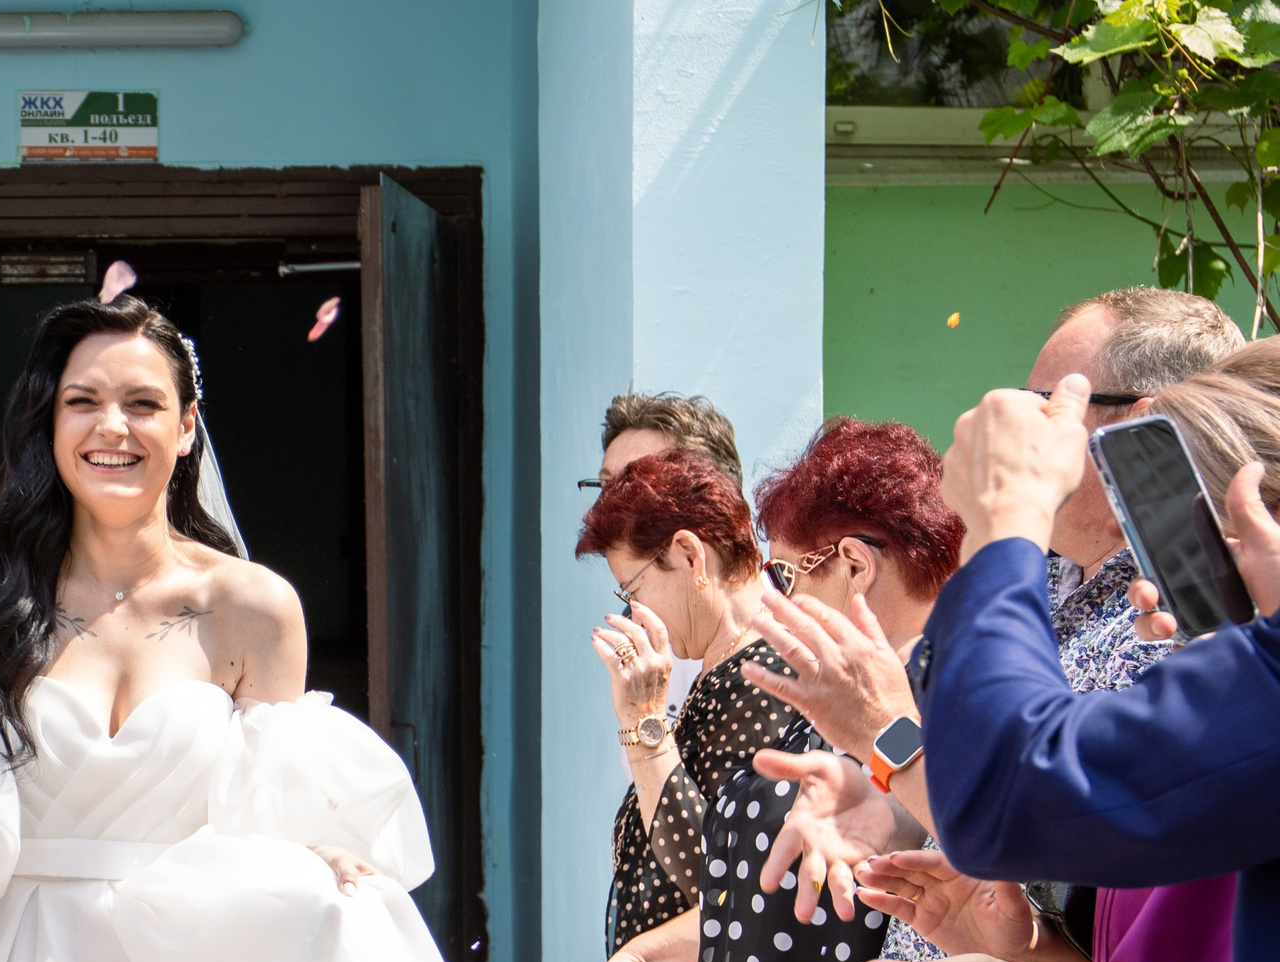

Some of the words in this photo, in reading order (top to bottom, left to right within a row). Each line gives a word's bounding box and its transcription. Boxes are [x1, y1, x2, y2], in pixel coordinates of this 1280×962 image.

[21, 96, 64, 110] ЖКХ
[116, 92, 125, 111] 1
[21, 109, 65, 118] ОНЛАЙН
[90, 114, 152, 125] подъезд
[48, 133, 75, 144] кв.
[82, 129, 118, 144] 1-40
